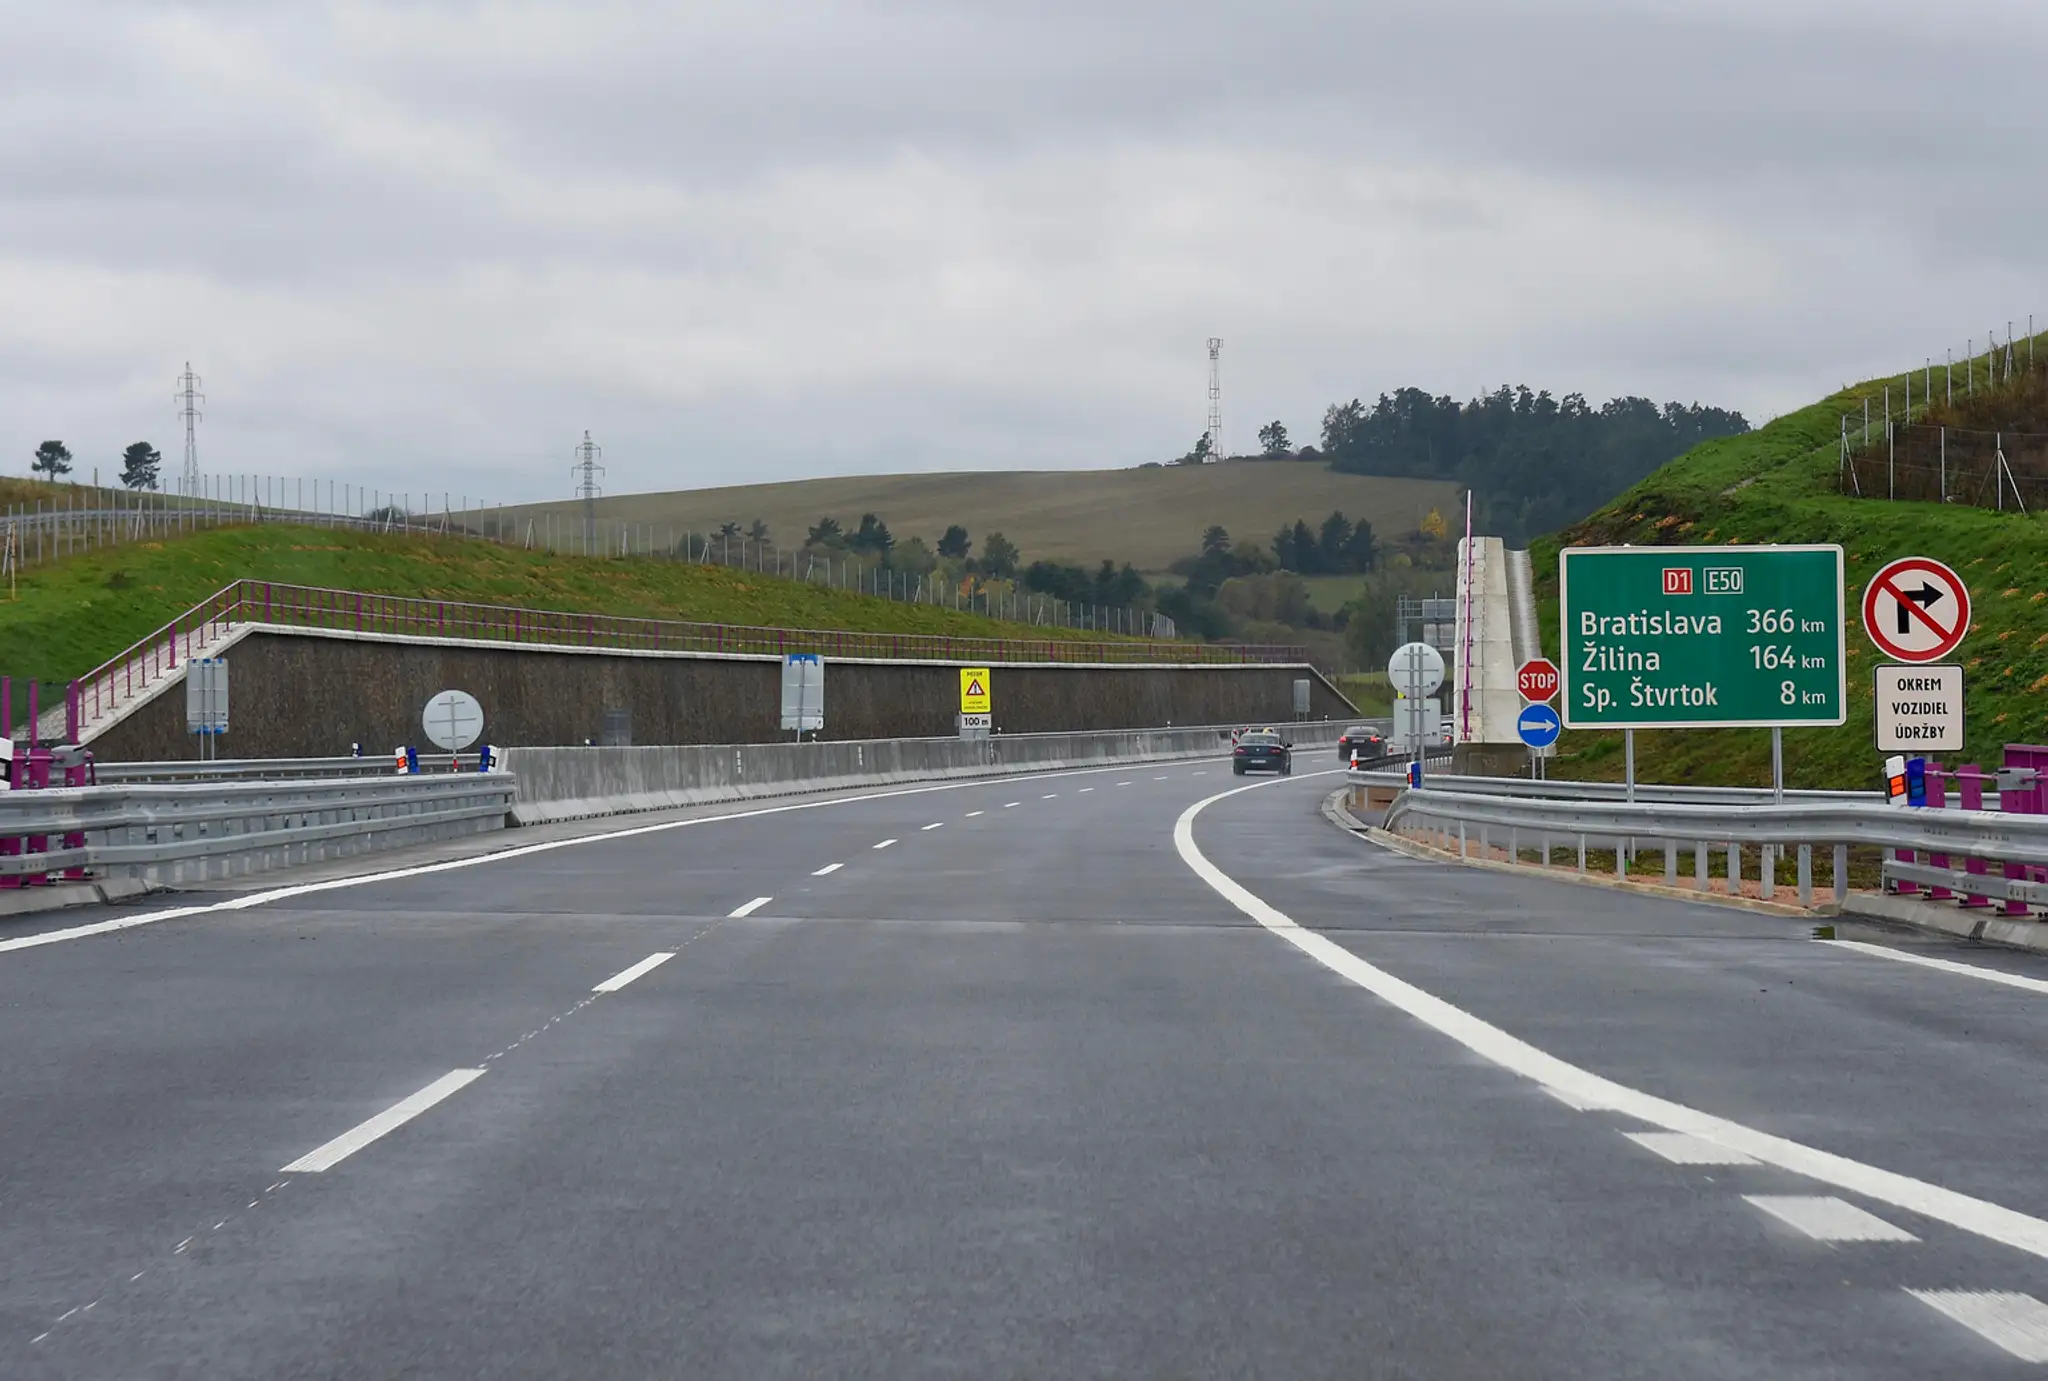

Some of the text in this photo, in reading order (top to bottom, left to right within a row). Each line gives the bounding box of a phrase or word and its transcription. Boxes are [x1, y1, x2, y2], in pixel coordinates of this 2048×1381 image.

[1667, 571, 1688, 591] D1
[1709, 570, 1741, 591] E50
[1582, 609, 1825, 635] Bratislava 366 km
[1583, 641, 1825, 671] Žilina 164 km
[1520, 674, 1556, 689] STOP
[1897, 678, 1941, 691] OKREM
[1583, 676, 1825, 712] Sp. Štvrtok 8 km
[1892, 702, 1948, 715] VOZIDIEL
[965, 717, 980, 726] 100
[1895, 722, 1945, 738] ÚDRŽBY
